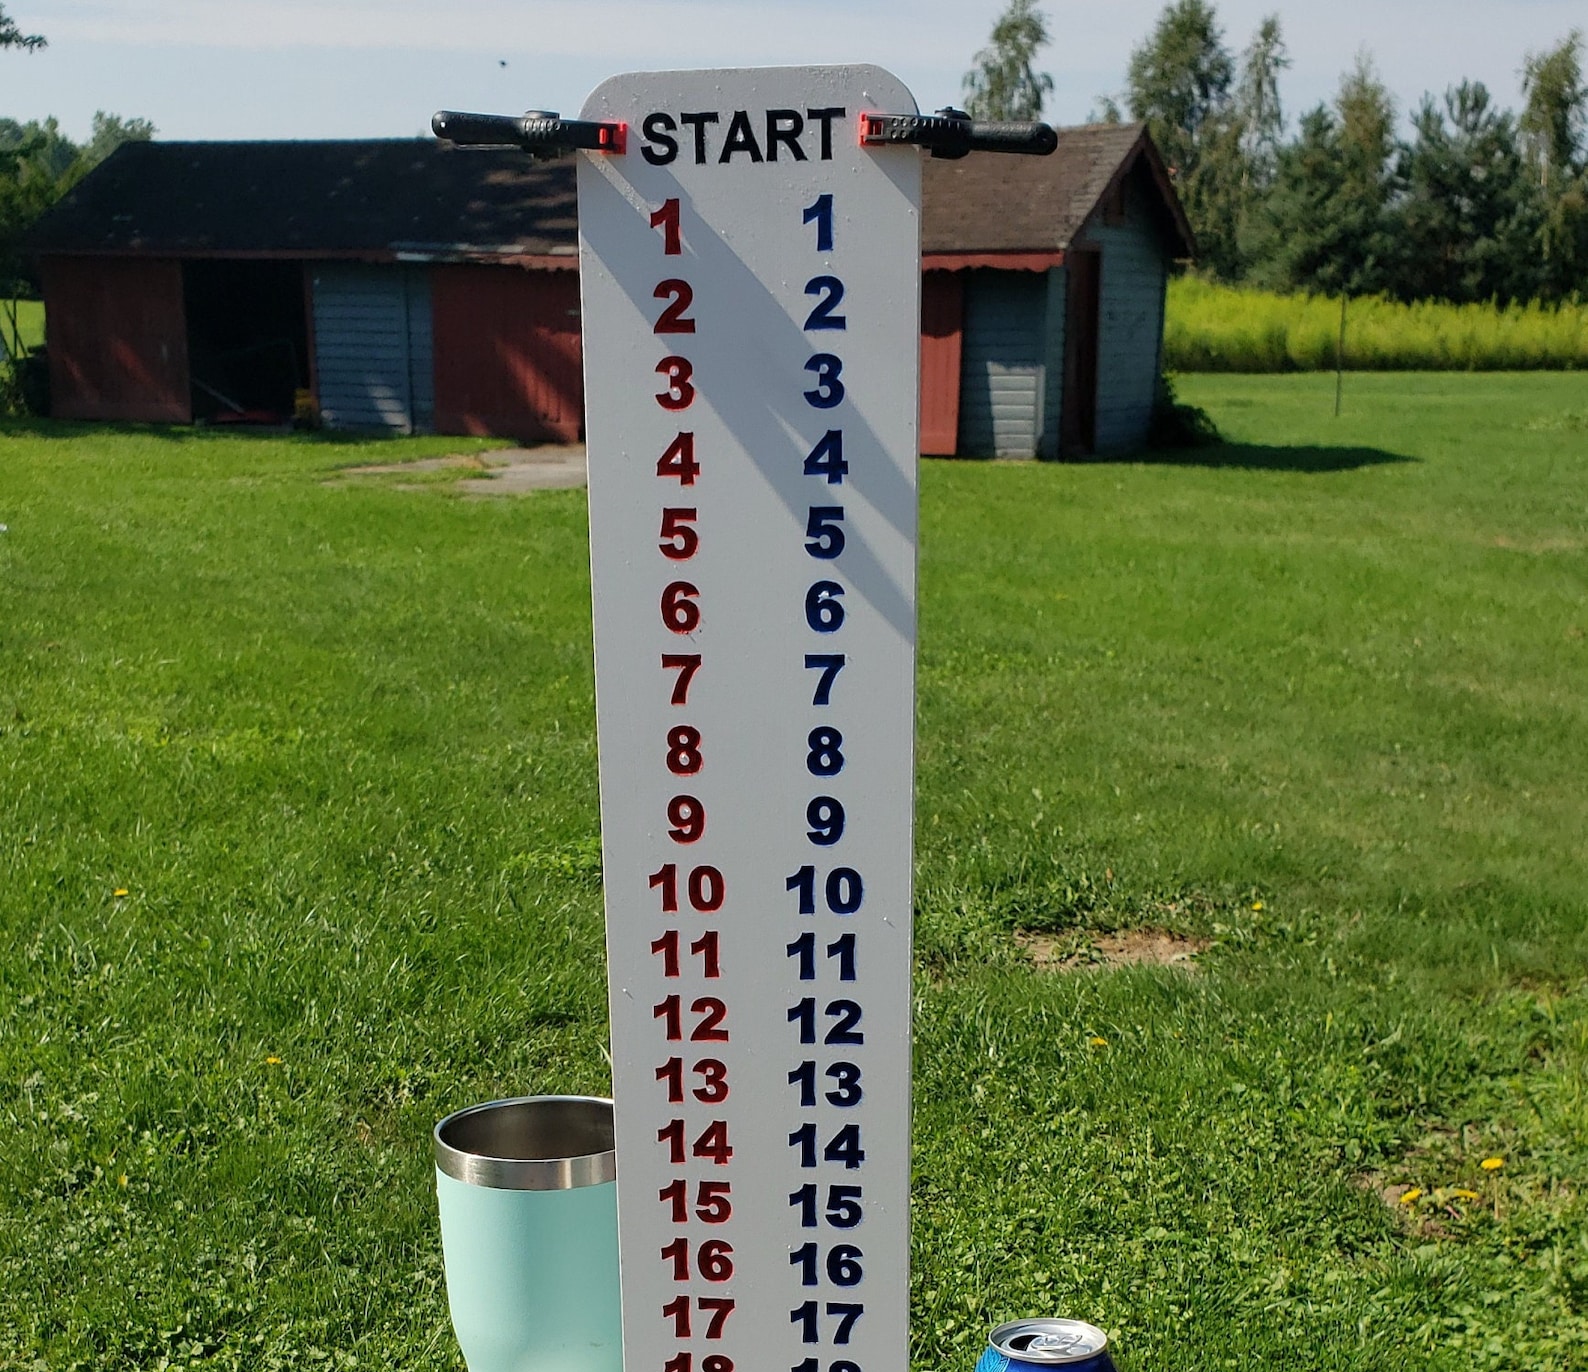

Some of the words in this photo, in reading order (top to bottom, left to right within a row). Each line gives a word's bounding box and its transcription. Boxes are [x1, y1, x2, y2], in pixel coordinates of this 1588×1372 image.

[640, 107, 846, 166] START
[650, 199, 681, 254] 1
[803, 193, 835, 252] 1
[654, 279, 695, 334] 2
[804, 274, 847, 331] 2
[656, 356, 696, 412] 3
[804, 352, 845, 411] 3
[657, 432, 701, 487] 4
[804, 426, 848, 486] 4
[659, 508, 700, 562] 5
[805, 502, 846, 560] 5
[661, 582, 700, 635] 6
[806, 579, 846, 635] 6
[662, 654, 702, 706] 7
[805, 653, 845, 706] 7
[667, 726, 704, 777] 8
[807, 727, 846, 778] 8
[668, 795, 706, 845] 9
[807, 796, 847, 847] 9
[649, 864, 726, 914] 10
[786, 866, 865, 917] 10
[652, 931, 720, 979] 11
[787, 933, 856, 981] 11
[654, 995, 729, 1043] 12
[788, 998, 863, 1046] 12
[656, 1057, 730, 1105] 13
[788, 1061, 863, 1108] 13
[658, 1120, 734, 1166] 14
[789, 1123, 864, 1168] 14
[660, 1180, 733, 1225] 15
[789, 1184, 862, 1230] 15
[661, 1238, 735, 1284] 16
[790, 1243, 863, 1288] 16
[663, 1296, 735, 1340] 17
[791, 1301, 863, 1345] 17
